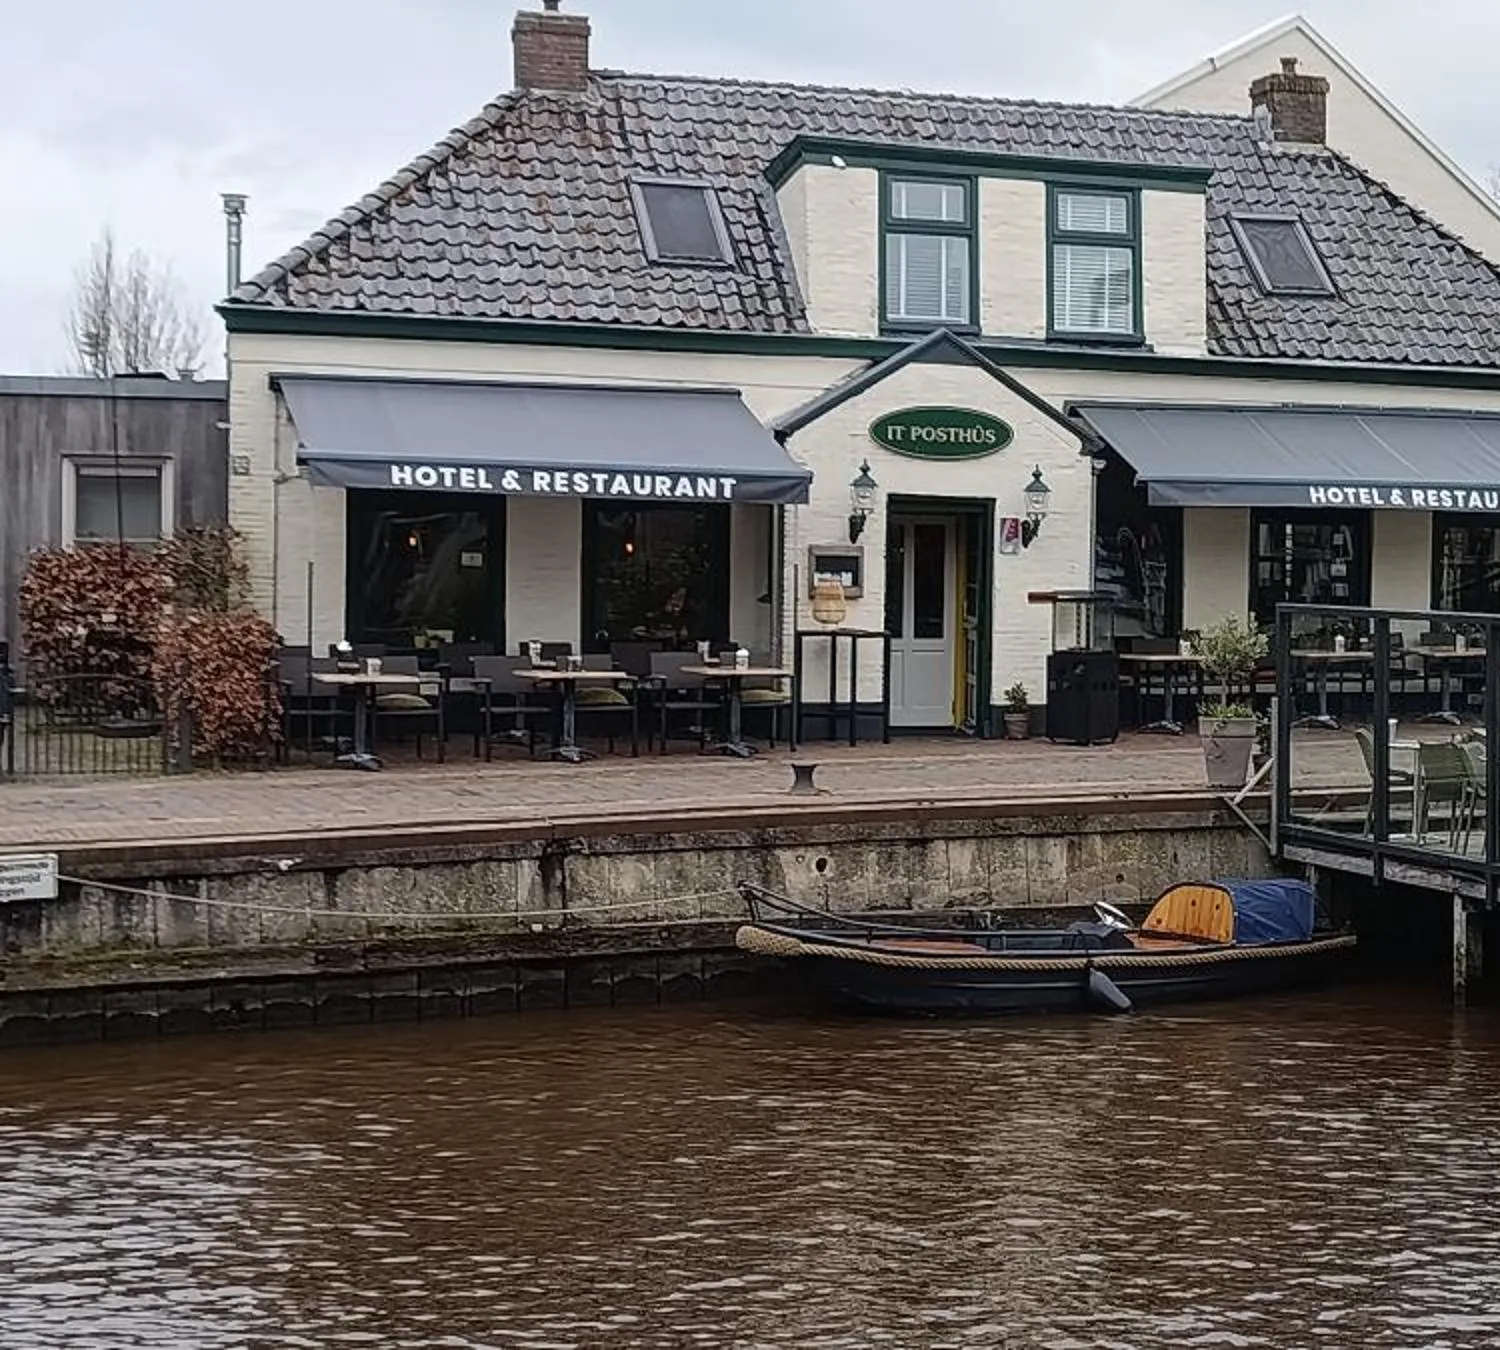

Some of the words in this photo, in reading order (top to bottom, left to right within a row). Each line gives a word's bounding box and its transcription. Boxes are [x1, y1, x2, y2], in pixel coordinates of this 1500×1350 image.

[887, 425, 906, 440] IT
[390, 465, 493, 490] HOTEL
[500, 469, 522, 491] &
[533, 471, 737, 499] RESTAURANT
[1309, 486, 1385, 505] HOTEL
[1390, 487, 1405, 505] &
